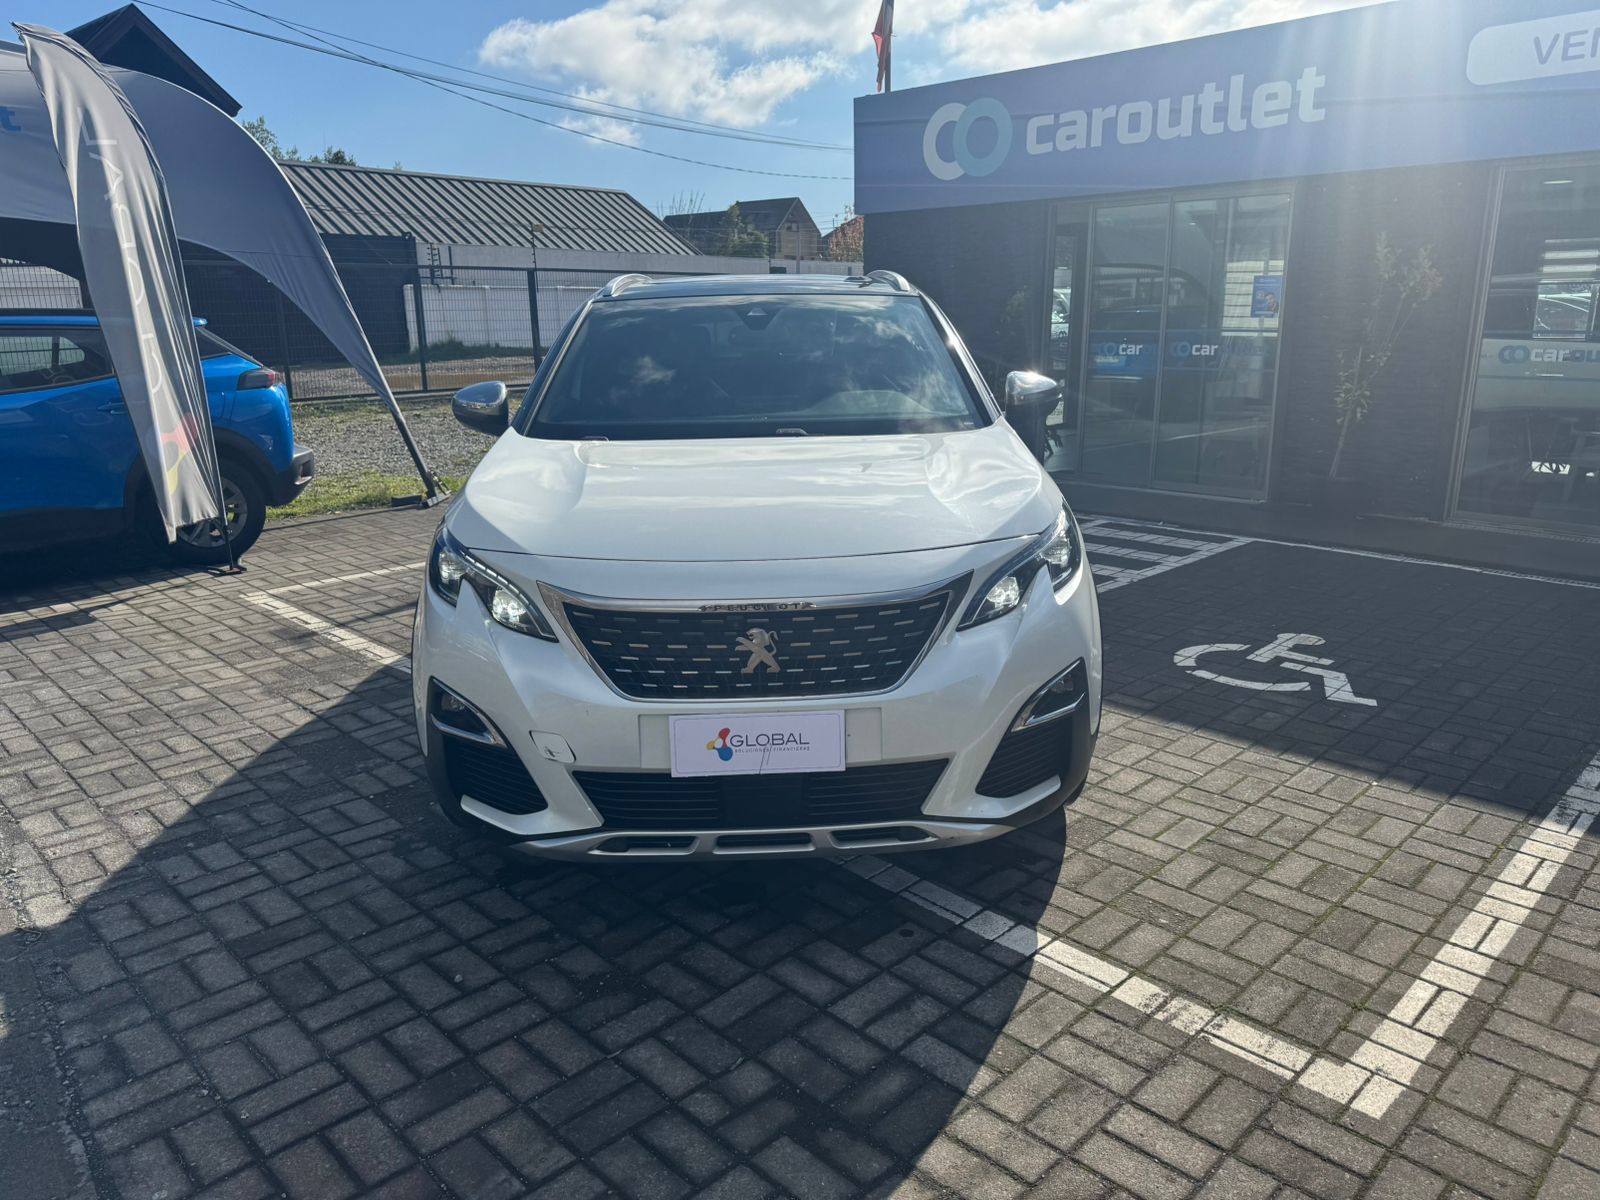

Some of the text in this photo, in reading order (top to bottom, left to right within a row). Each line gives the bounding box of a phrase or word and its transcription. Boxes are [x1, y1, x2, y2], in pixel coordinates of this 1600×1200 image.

[1026, 66, 1326, 155] caroutlet
[714, 603, 801, 612] PEUGOT
[730, 733, 810, 747] GLOBAL
